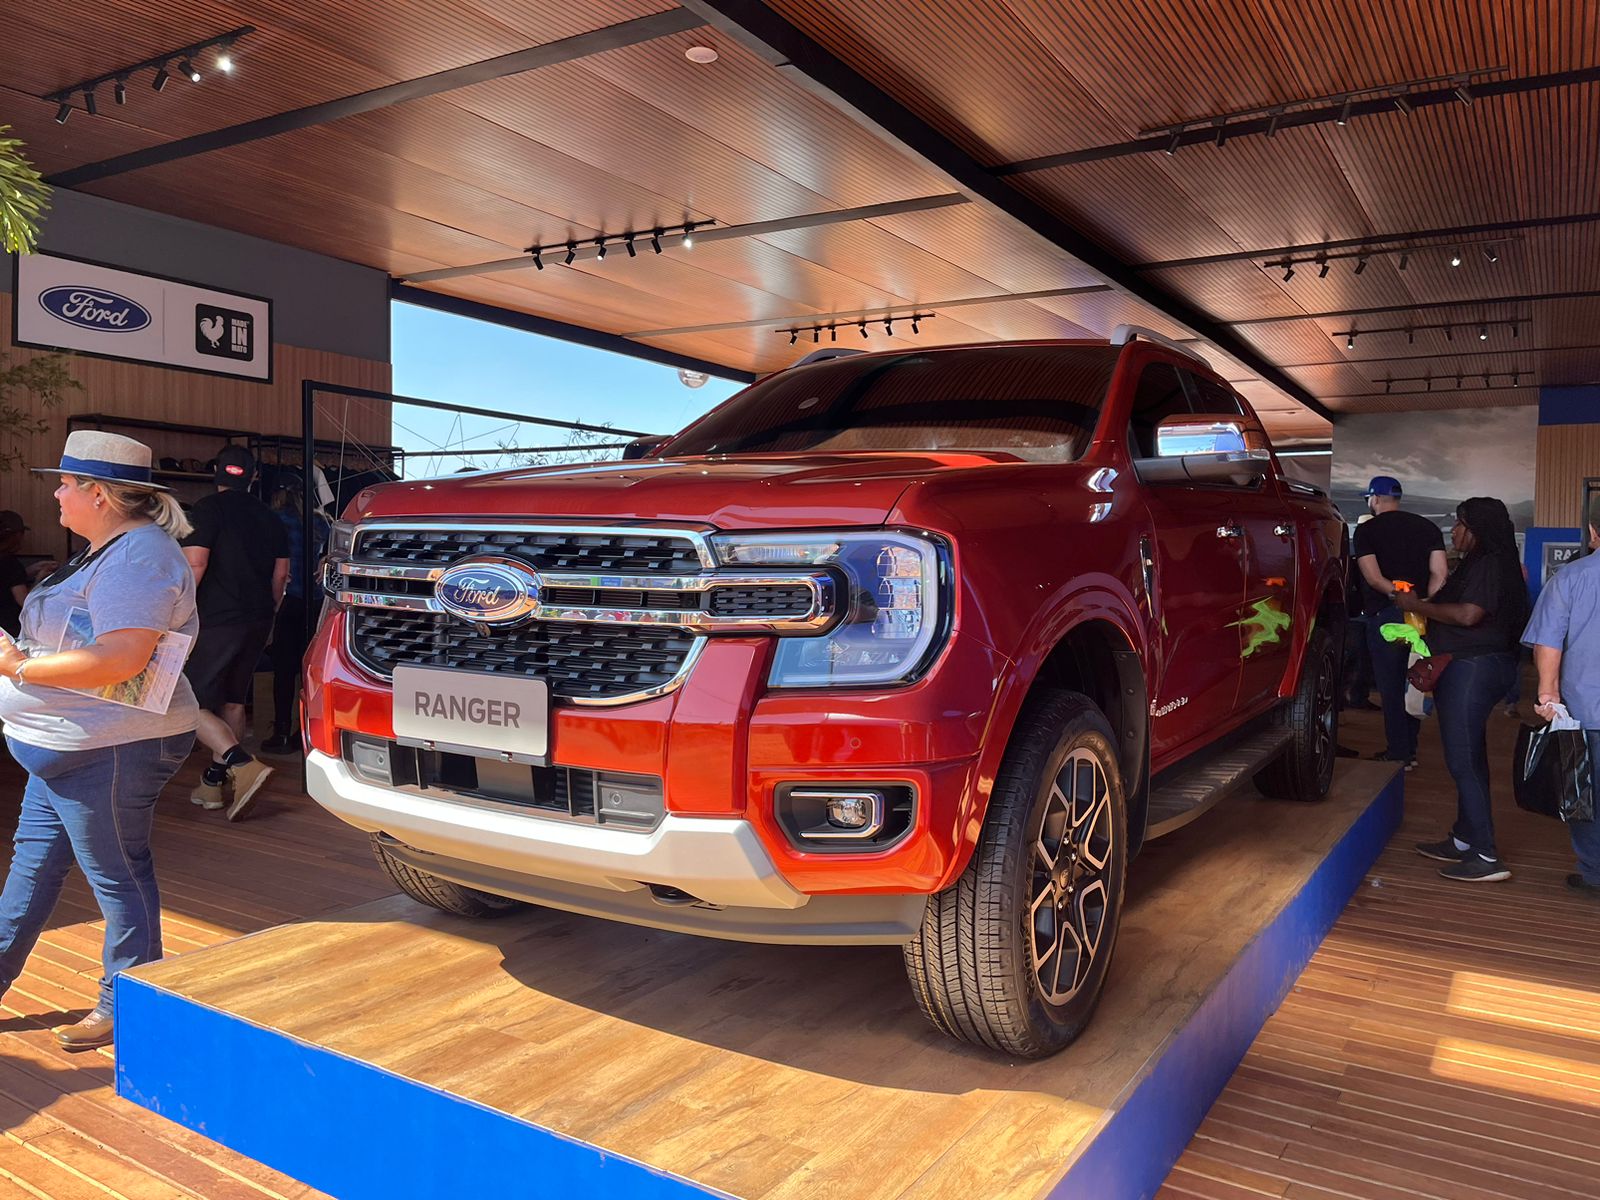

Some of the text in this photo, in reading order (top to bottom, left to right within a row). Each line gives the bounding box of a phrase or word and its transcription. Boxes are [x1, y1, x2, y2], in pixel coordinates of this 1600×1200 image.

[62, 292, 130, 327] Ford
[231, 325, 248, 347] IN
[1554, 549, 1579, 561] RA
[454, 577, 501, 605] Ford
[415, 691, 521, 728] RANGER
